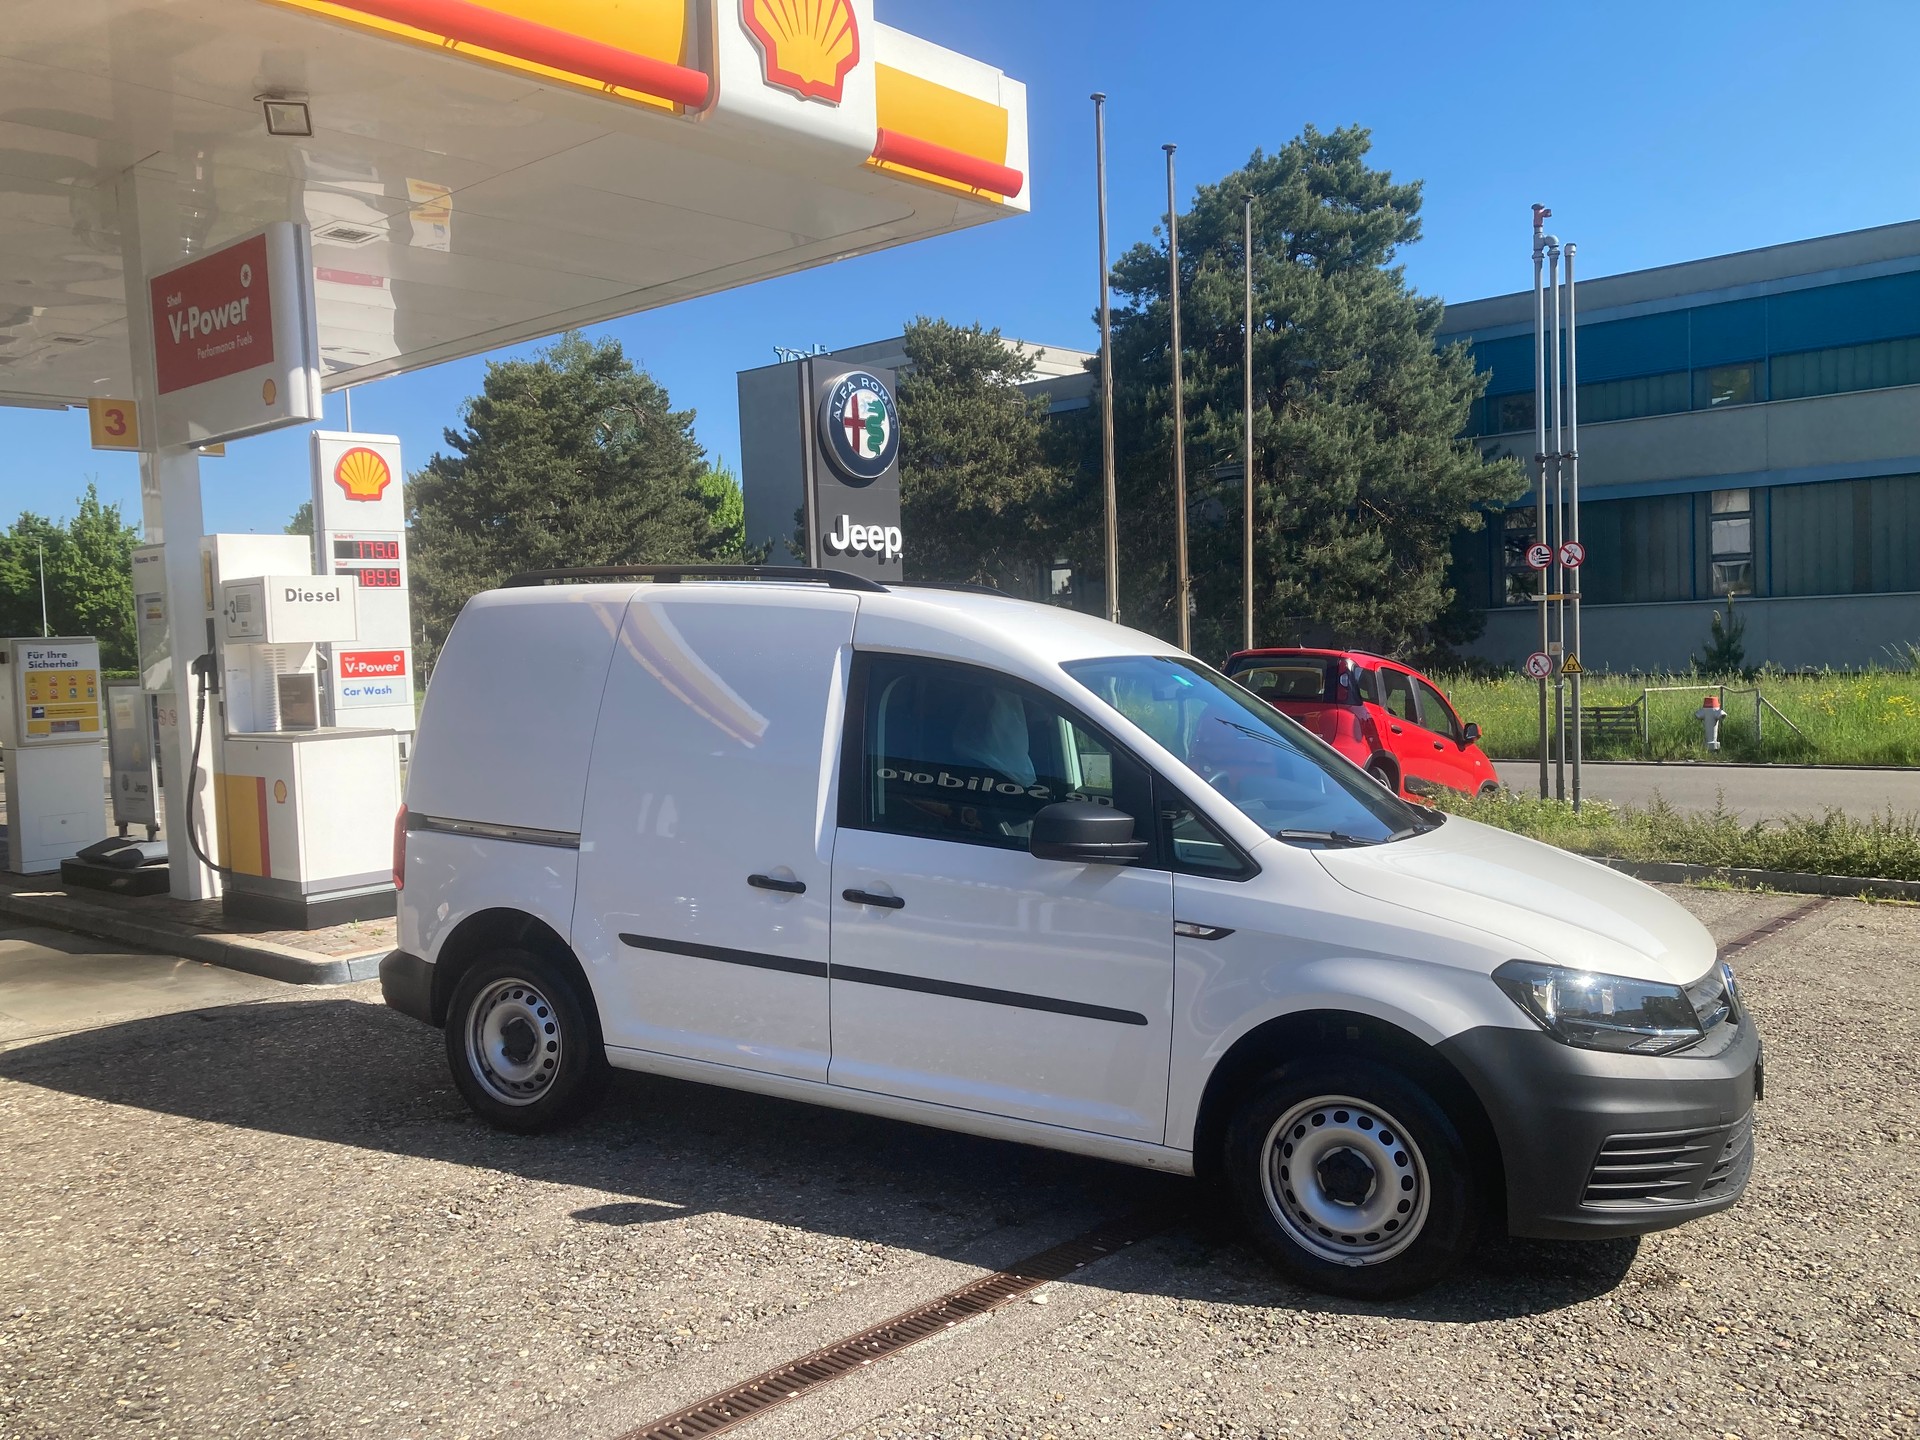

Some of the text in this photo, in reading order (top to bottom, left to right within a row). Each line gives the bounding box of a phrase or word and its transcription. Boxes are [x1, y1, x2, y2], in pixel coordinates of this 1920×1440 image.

[168, 296, 250, 344] V-Power
[197, 331, 253, 360] Performance Fuels
[833, 377, 897, 430] ALFA ROMEO
[104, 408, 127, 436] 3
[830, 514, 903, 559] Jeep
[358, 541, 399, 559] 179.0
[359, 569, 400, 587] 189.9
[285, 587, 340, 602] Diesel
[229, 600, 237, 623] 3
[27, 651, 68, 659] Für Ihre
[28, 659, 79, 669] Sicherheit
[345, 662, 399, 674] V-Power
[1567, 663, 1577, 671] EX
[343, 685, 393, 697] Car Wash
